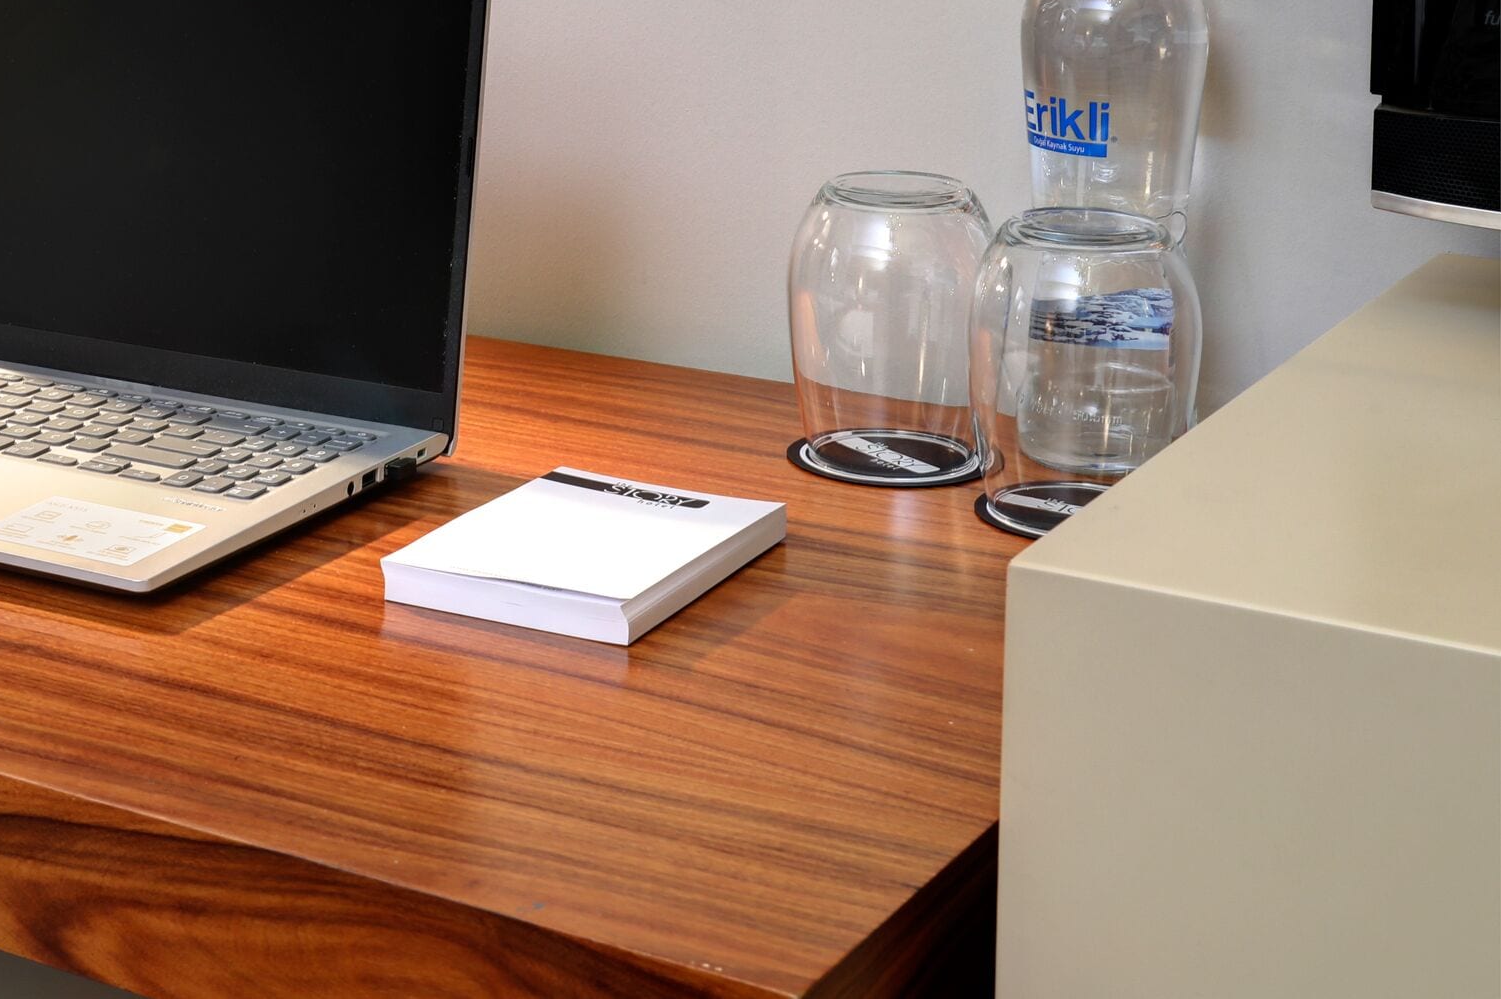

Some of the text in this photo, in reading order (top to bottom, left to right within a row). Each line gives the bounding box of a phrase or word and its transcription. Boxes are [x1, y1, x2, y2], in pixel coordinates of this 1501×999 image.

[1024, 89, 1110, 142] Erikli
[1068, 142, 1085, 154] Suyu
[604, 484, 694, 507] STORY
[637, 499, 675, 510] hotel
